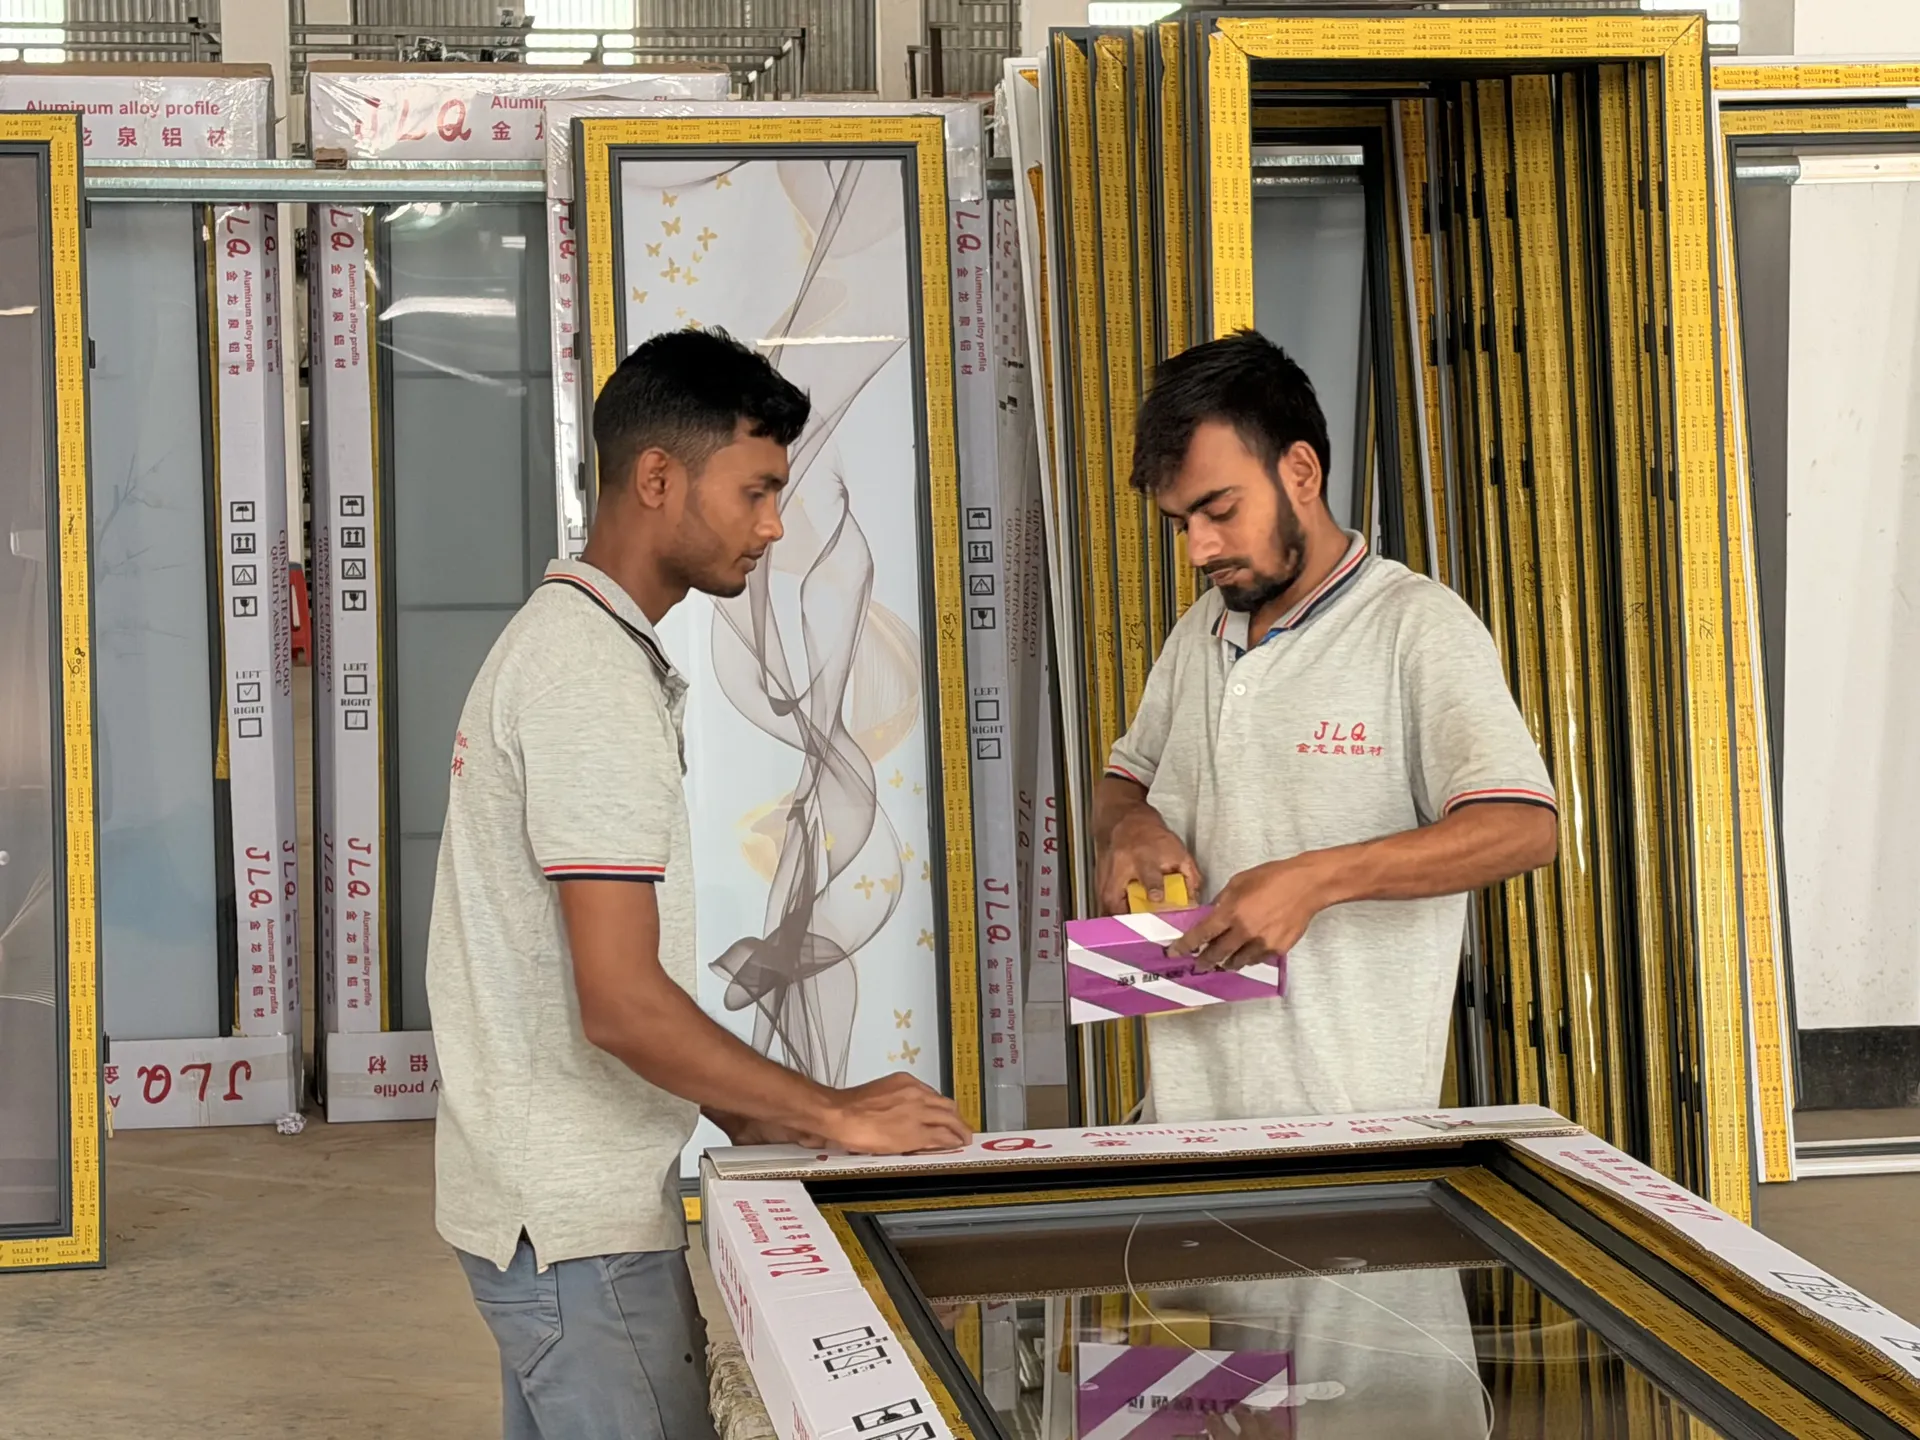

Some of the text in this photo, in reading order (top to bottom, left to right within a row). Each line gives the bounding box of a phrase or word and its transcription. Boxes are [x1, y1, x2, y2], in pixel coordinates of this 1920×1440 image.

[119, 101, 160, 118] alloy
[166, 100, 220, 117] profile
[975, 266, 987, 372] Aluminum alloy profile
[236, 670, 262, 680] LEFT
[343, 663, 368, 671] LEFT
[341, 698, 372, 707] RIGHT
[973, 687, 1000, 697] LEFT
[234, 706, 264, 715] RIGHT
[971, 725, 1005, 735] RIGHT
[1314, 721, 1367, 741] JLQ
[1019, 790, 1032, 849] JLQ
[245, 847, 273, 908] JLQ
[283, 840, 297, 900] JLQ
[323, 833, 334, 895] JLQ
[347, 838, 372, 899] JLQ
[983, 878, 1012, 945] JLQ
[1005, 957, 1018, 1065] Aluminum alloy profile
[136, 1060, 252, 1104] JLQ
[373, 1081, 425, 1098] profile
[1081, 1125, 1248, 1138] Aluminum
[1261, 1121, 1334, 1132] alloy
[1634, 1191, 1723, 1221] JLQ
[760, 1243, 830, 1278] JLQ
